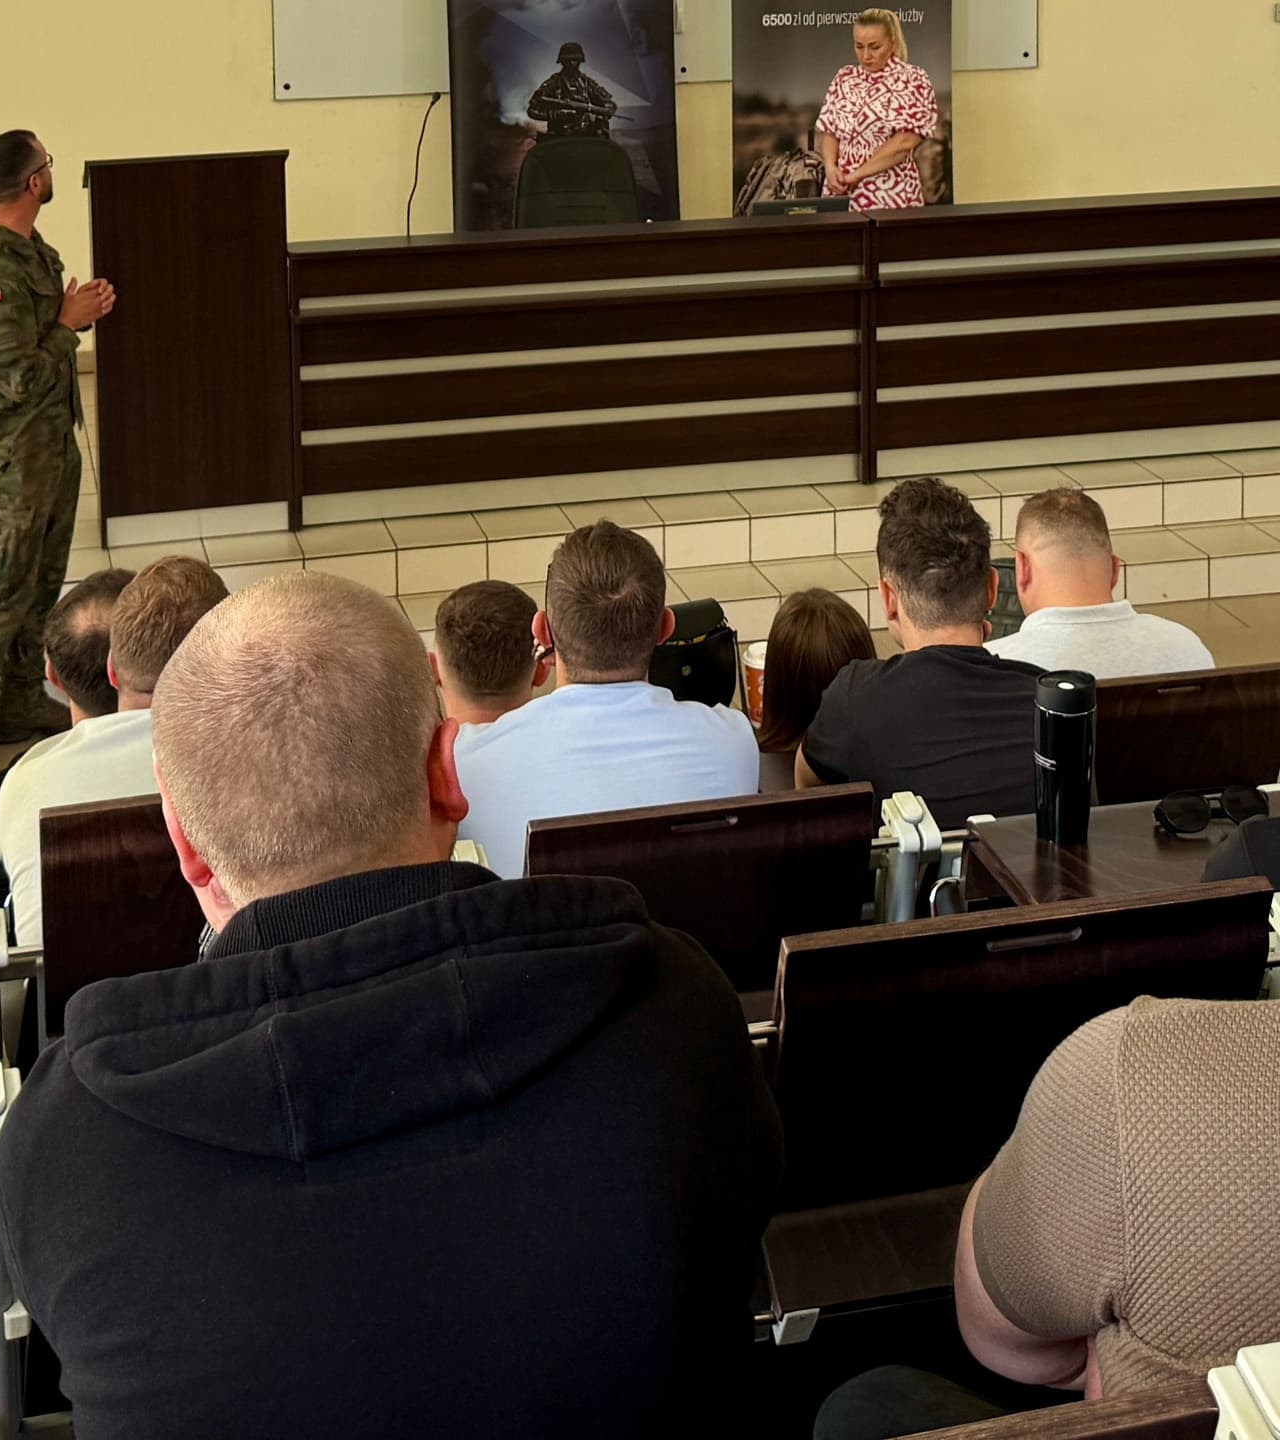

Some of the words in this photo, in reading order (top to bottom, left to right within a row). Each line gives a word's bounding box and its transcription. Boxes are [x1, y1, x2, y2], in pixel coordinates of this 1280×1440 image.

[761, 12, 792, 27] 6500
[793, 11, 802, 27] zł
[803, 11, 815, 27] od
